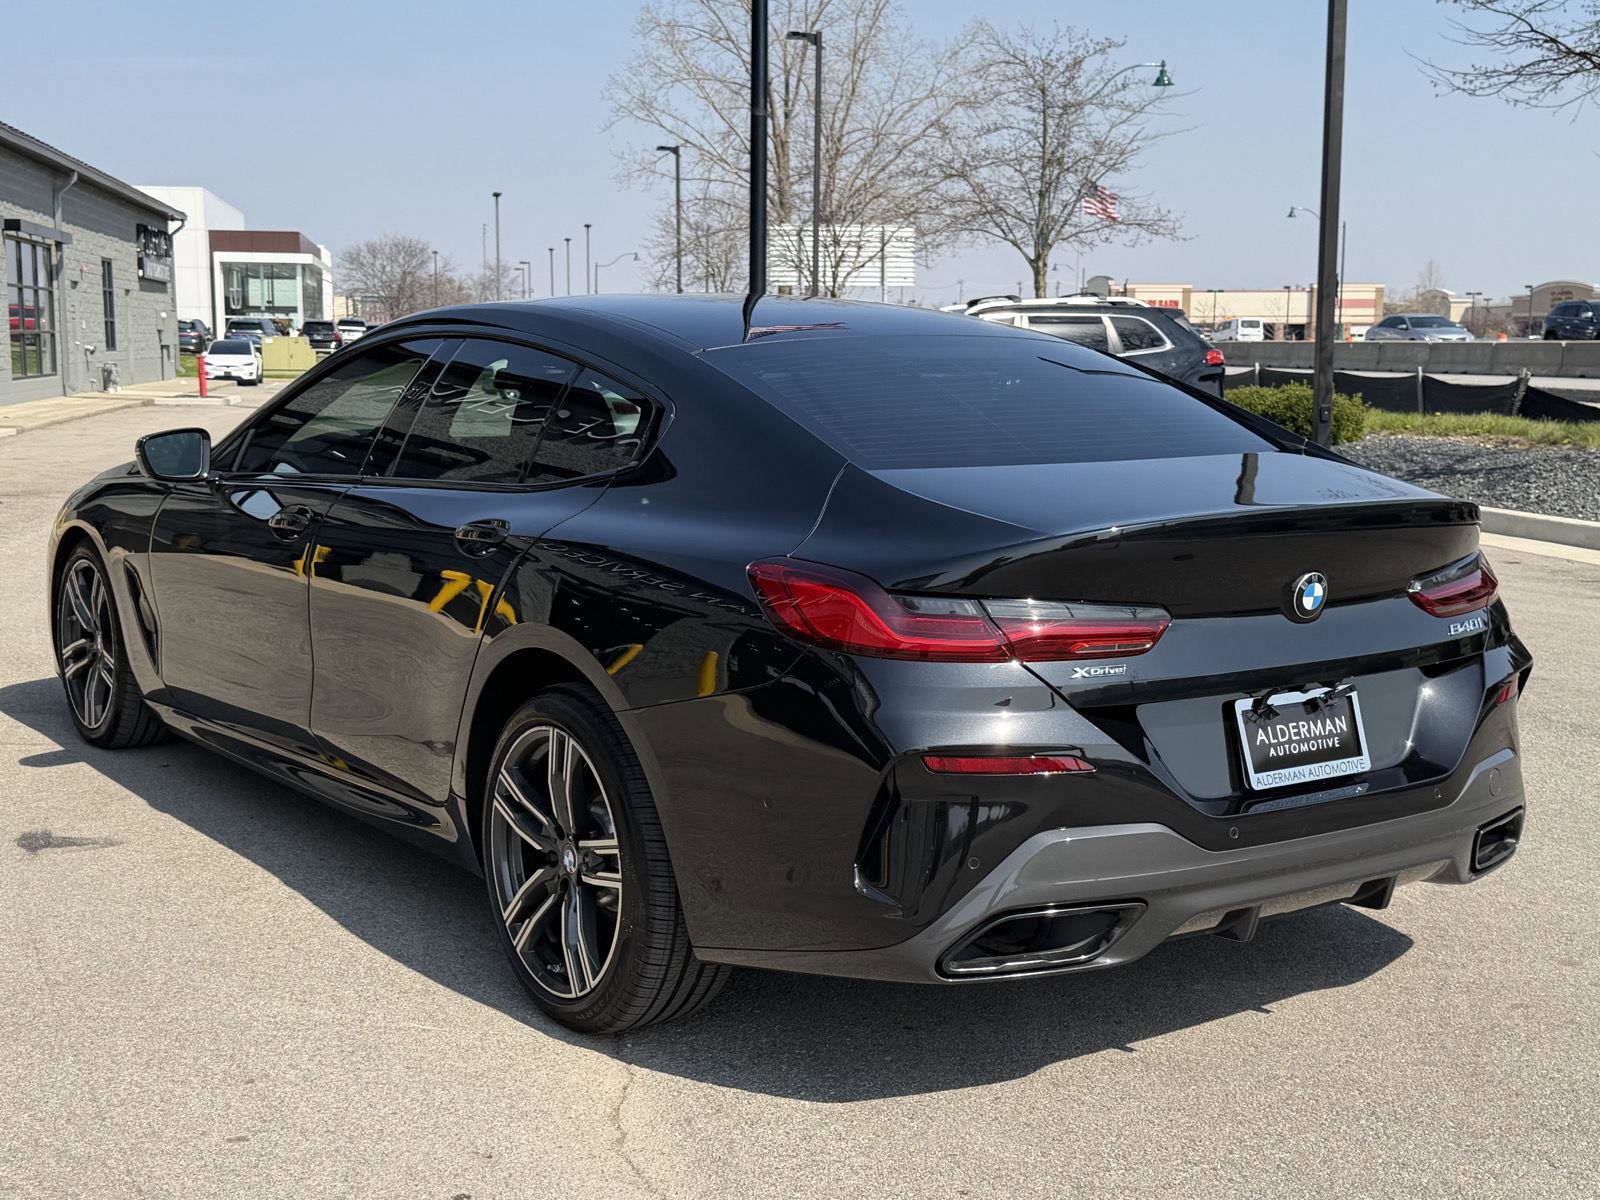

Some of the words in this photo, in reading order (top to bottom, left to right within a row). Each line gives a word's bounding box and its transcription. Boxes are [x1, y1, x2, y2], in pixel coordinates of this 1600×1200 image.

[1256, 715, 1347, 746] ALDERMAN
[1269, 736, 1340, 758] AUTOMOTIVE
[1256, 769, 1306, 788] ALDERMAN
[1308, 758, 1365, 779] AUTOMOTIVE
